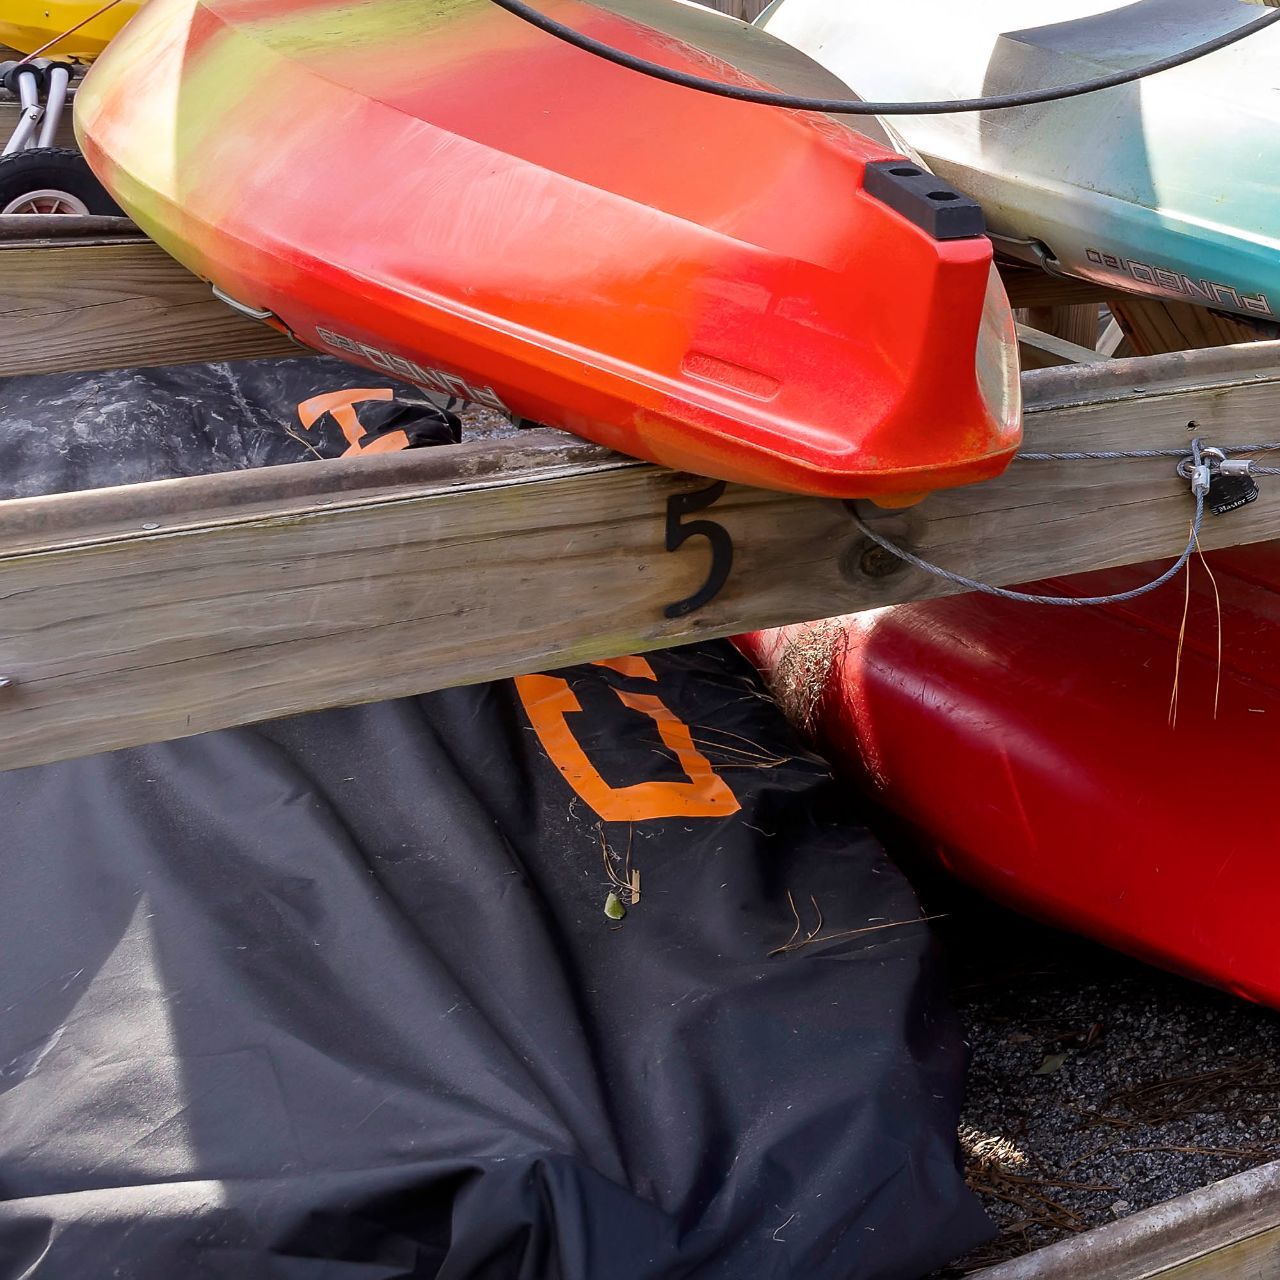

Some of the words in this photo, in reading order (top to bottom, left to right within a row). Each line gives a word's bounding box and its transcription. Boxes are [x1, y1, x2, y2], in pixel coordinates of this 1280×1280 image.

[1127, 259, 1274, 317] PUNGO
[1218, 498, 1247, 513] Master
[664, 481, 734, 619] 5
